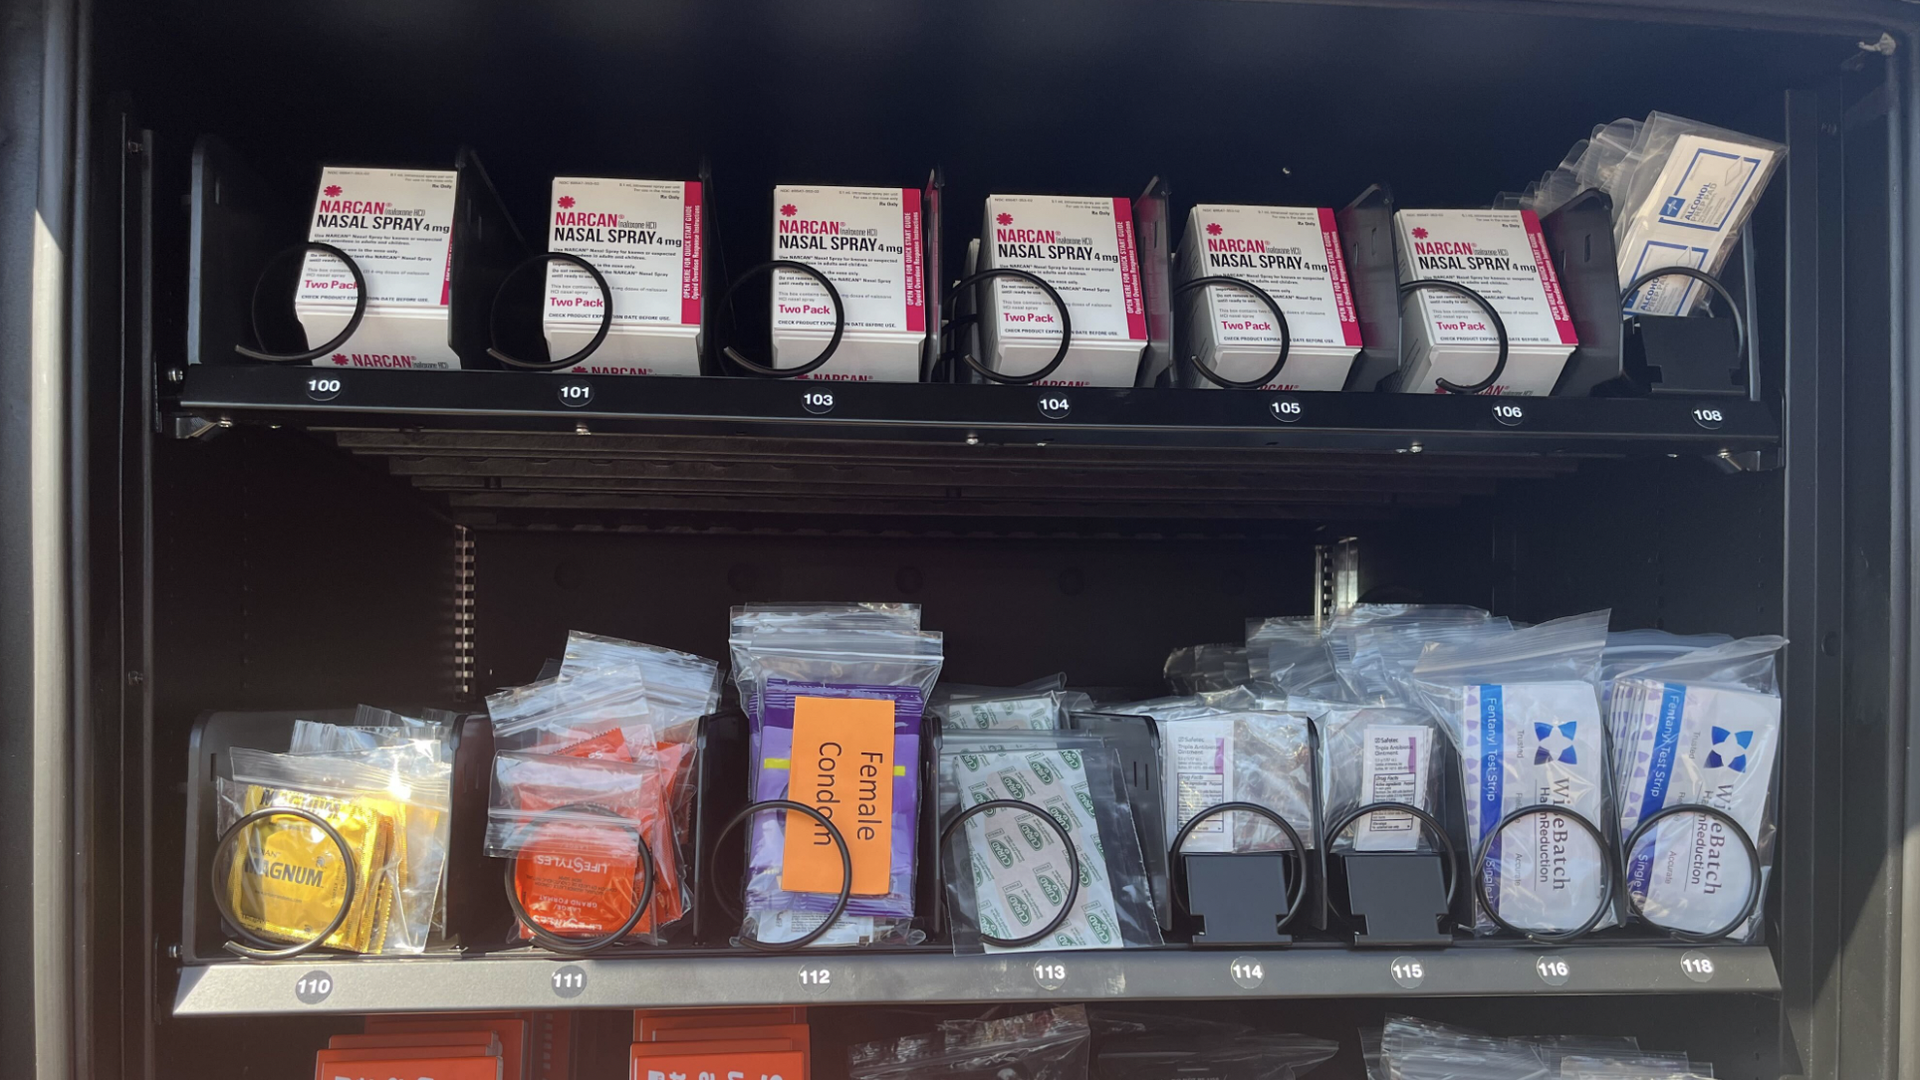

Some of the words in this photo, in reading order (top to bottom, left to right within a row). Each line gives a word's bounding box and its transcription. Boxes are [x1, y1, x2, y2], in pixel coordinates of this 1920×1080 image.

[1685, 183, 1711, 220] ALCOHOL
[1691, 202, 1706, 222] PREP
[1703, 183, 1718, 200] PAD
[317, 215, 371, 229] NASAL
[373, 216, 424, 231] SPRAY
[432, 225, 449, 233] mg
[555, 228, 603, 242] NASAL
[608, 230, 656, 245] SPRAY
[656, 237, 663, 245] 4
[665, 238, 682, 247] mg
[1125, 221, 1133, 249] Instructions
[1324, 232, 1332, 247] GUIDE
[1529, 233, 1539, 248] GUIDE
[779, 236, 827, 250] NASAL
[831, 237, 877, 251] SPRAY
[878, 244, 884, 252] 4
[886, 245, 902, 254] mg
[913, 242, 921, 264] Response
[1119, 239, 1127, 254] START
[999, 244, 1046, 258] NASAL
[1049, 246, 1092, 260] SPRAY
[1102, 254, 1118, 263] mg
[1128, 250, 1138, 273] Response
[1327, 249, 1335, 264] START
[1534, 250, 1544, 264] START
[1121, 256, 1129, 272] QUICK
[1210, 254, 1257, 267] NASAL
[1260, 255, 1302, 269] SPRAY
[1304, 262, 1310, 270] 4
[1312, 263, 1328, 272] mg
[1419, 257, 1466, 270] NASAL
[1468, 257, 1510, 271] SPRAY
[1520, 265, 1536, 273] mg
[1330, 265, 1339, 280] QUICK
[1539, 266, 1549, 281] QUICK
[305, 280, 328, 289] Two
[692, 283, 700, 299] Opioid
[1131, 274, 1139, 297] Overdose
[1544, 282, 1552, 291] FOR
[1336, 293, 1344, 306] HERE
[1547, 293, 1557, 305] HERE
[1640, 277, 1660, 310] ALCOHO
[551, 298, 572, 306] Two
[576, 298, 603, 307] Pack
[779, 305, 801, 314] Two
[803, 305, 830, 314] Pack
[1126, 299, 1134, 313] OPEN
[1134, 298, 1143, 314] Opioid
[1004, 313, 1025, 322] Two
[1028, 314, 1054, 323] Pack
[1339, 307, 1347, 321] OPEN
[1552, 307, 1561, 320] OPEN
[1222, 321, 1243, 330] Two
[1246, 322, 1271, 331] Pack
[1436, 322, 1458, 330] Two
[1460, 322, 1486, 331] Pack
[309, 380, 340, 391] 100
[561, 387, 590, 397] 101
[804, 394, 833, 405] 103
[1040, 399, 1069, 409] 104
[1272, 403, 1300, 413] 105
[1494, 406, 1522, 417] 106
[1694, 409, 1722, 421] 108
[1486, 698, 1498, 745] Fentanyl
[1662, 695, 1679, 744] Fentanyl
[1689, 732, 1700, 759] Trusted
[1487, 749, 1498, 771] Test
[1657, 746, 1670, 767] Test
[1033, 762, 1050, 782] CURAD
[1005, 777, 1022, 798] CURAD
[1486, 774, 1498, 801] Strip
[1650, 770, 1665, 797] Strip
[814, 742, 842, 845] Condom
[857, 752, 883, 840] Female
[1022, 825, 1040, 847] CURAD
[1540, 787, 1550, 882] HamReduction
[1553, 777, 1570, 890] WieBatch
[1703, 784, 1734, 894] WieBatch
[992, 841, 1010, 865] CURAD
[537, 855, 607, 874] LIFESTYLES
[1514, 853, 1522, 886] Accurate
[1634, 855, 1648, 887] Single
[1665, 851, 1676, 884] Accurate
[1484, 861, 1495, 892] Single
[1040, 878, 1058, 902] CURAD
[538, 895, 568, 904] FORMAT
[570, 899, 597, 908] GRAND
[1010, 896, 1028, 922] CURAD
[1089, 915, 1108, 941] CURAD
[1036, 966, 1065, 979] 113
[1233, 964, 1262, 980] 114
[1393, 964, 1423, 979] 115
[1538, 962, 1568, 977] 116
[1683, 959, 1713, 973] 118
[554, 974, 583, 988] 111
[800, 970, 830, 984] 112
[298, 979, 330, 994] 110
